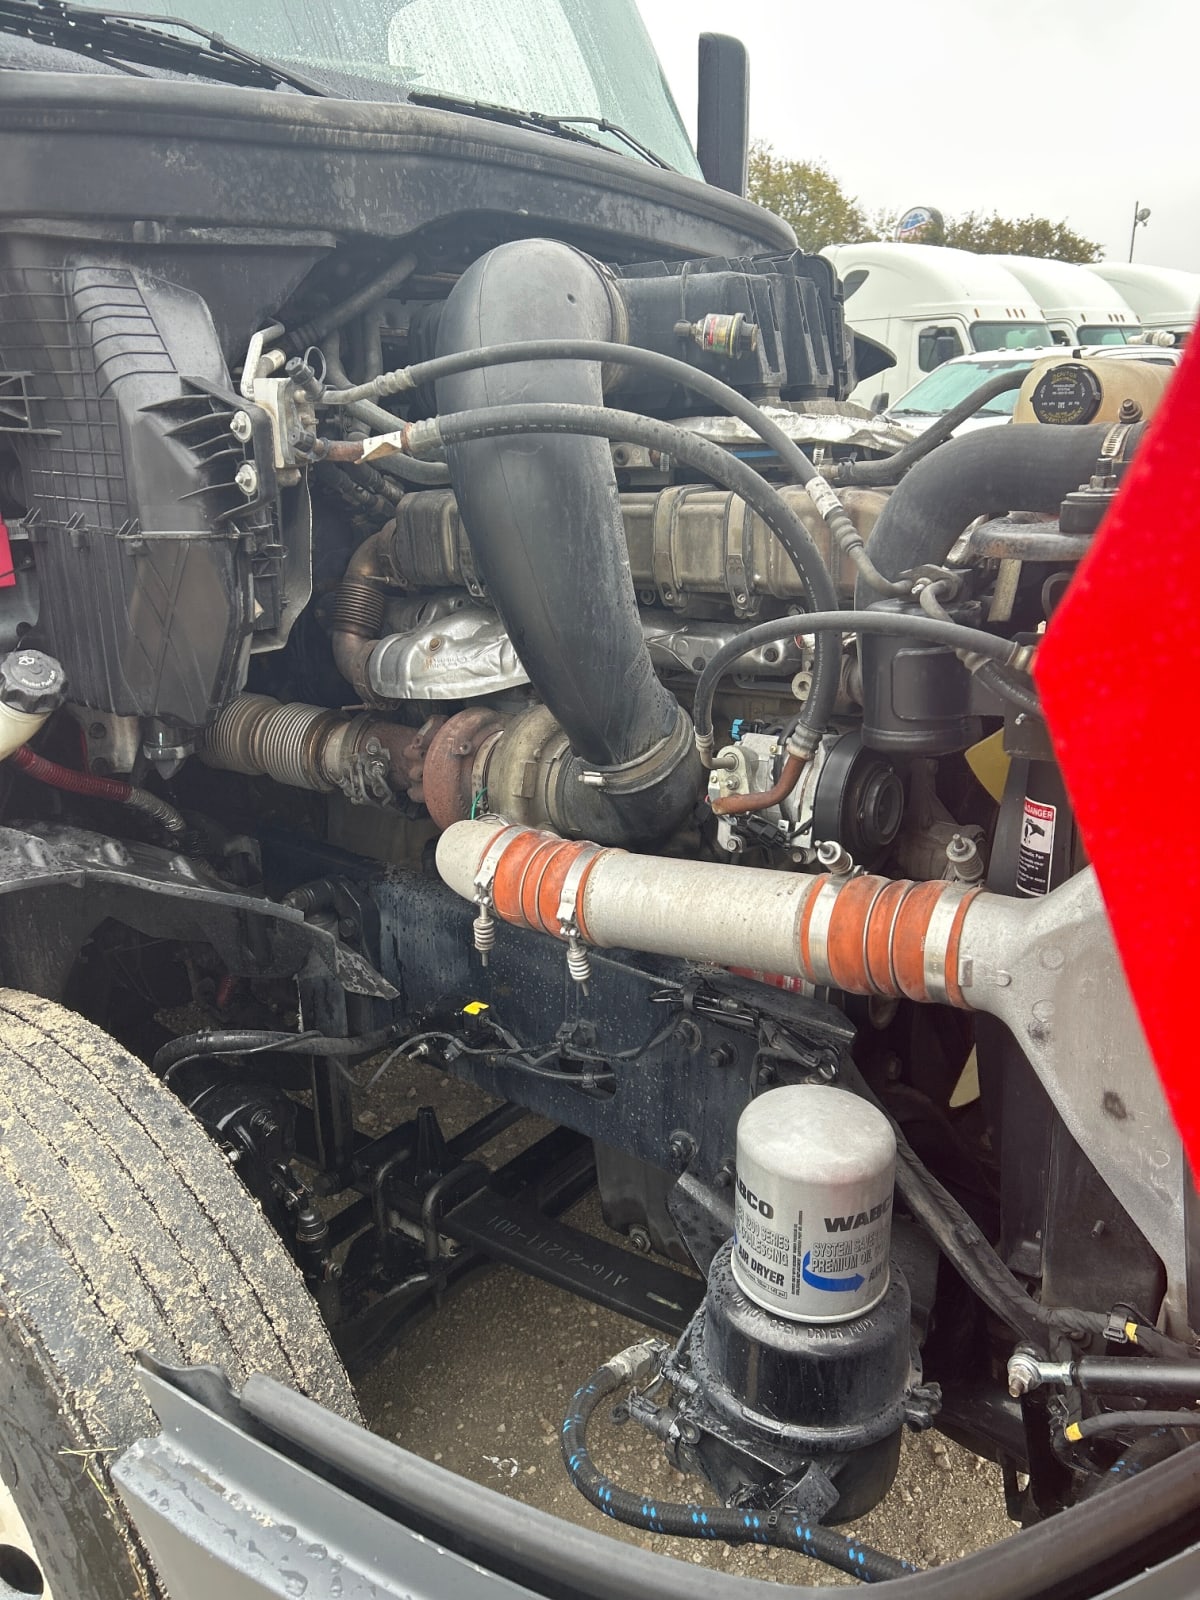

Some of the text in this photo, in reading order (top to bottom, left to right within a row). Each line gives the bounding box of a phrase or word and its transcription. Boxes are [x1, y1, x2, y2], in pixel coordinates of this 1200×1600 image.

[736, 1177, 774, 1219] BCO
[823, 1194, 893, 1233] WABC
[761, 1226, 790, 1251] SERIES
[812, 1239, 853, 1258] SYSTEM
[750, 1260, 785, 1287] DRYER
[811, 1255, 858, 1273] PREMIUM
[860, 1250, 873, 1266] OIL
[769, 1319, 800, 1337] OPEN
[807, 1327, 844, 1340] DRYER
